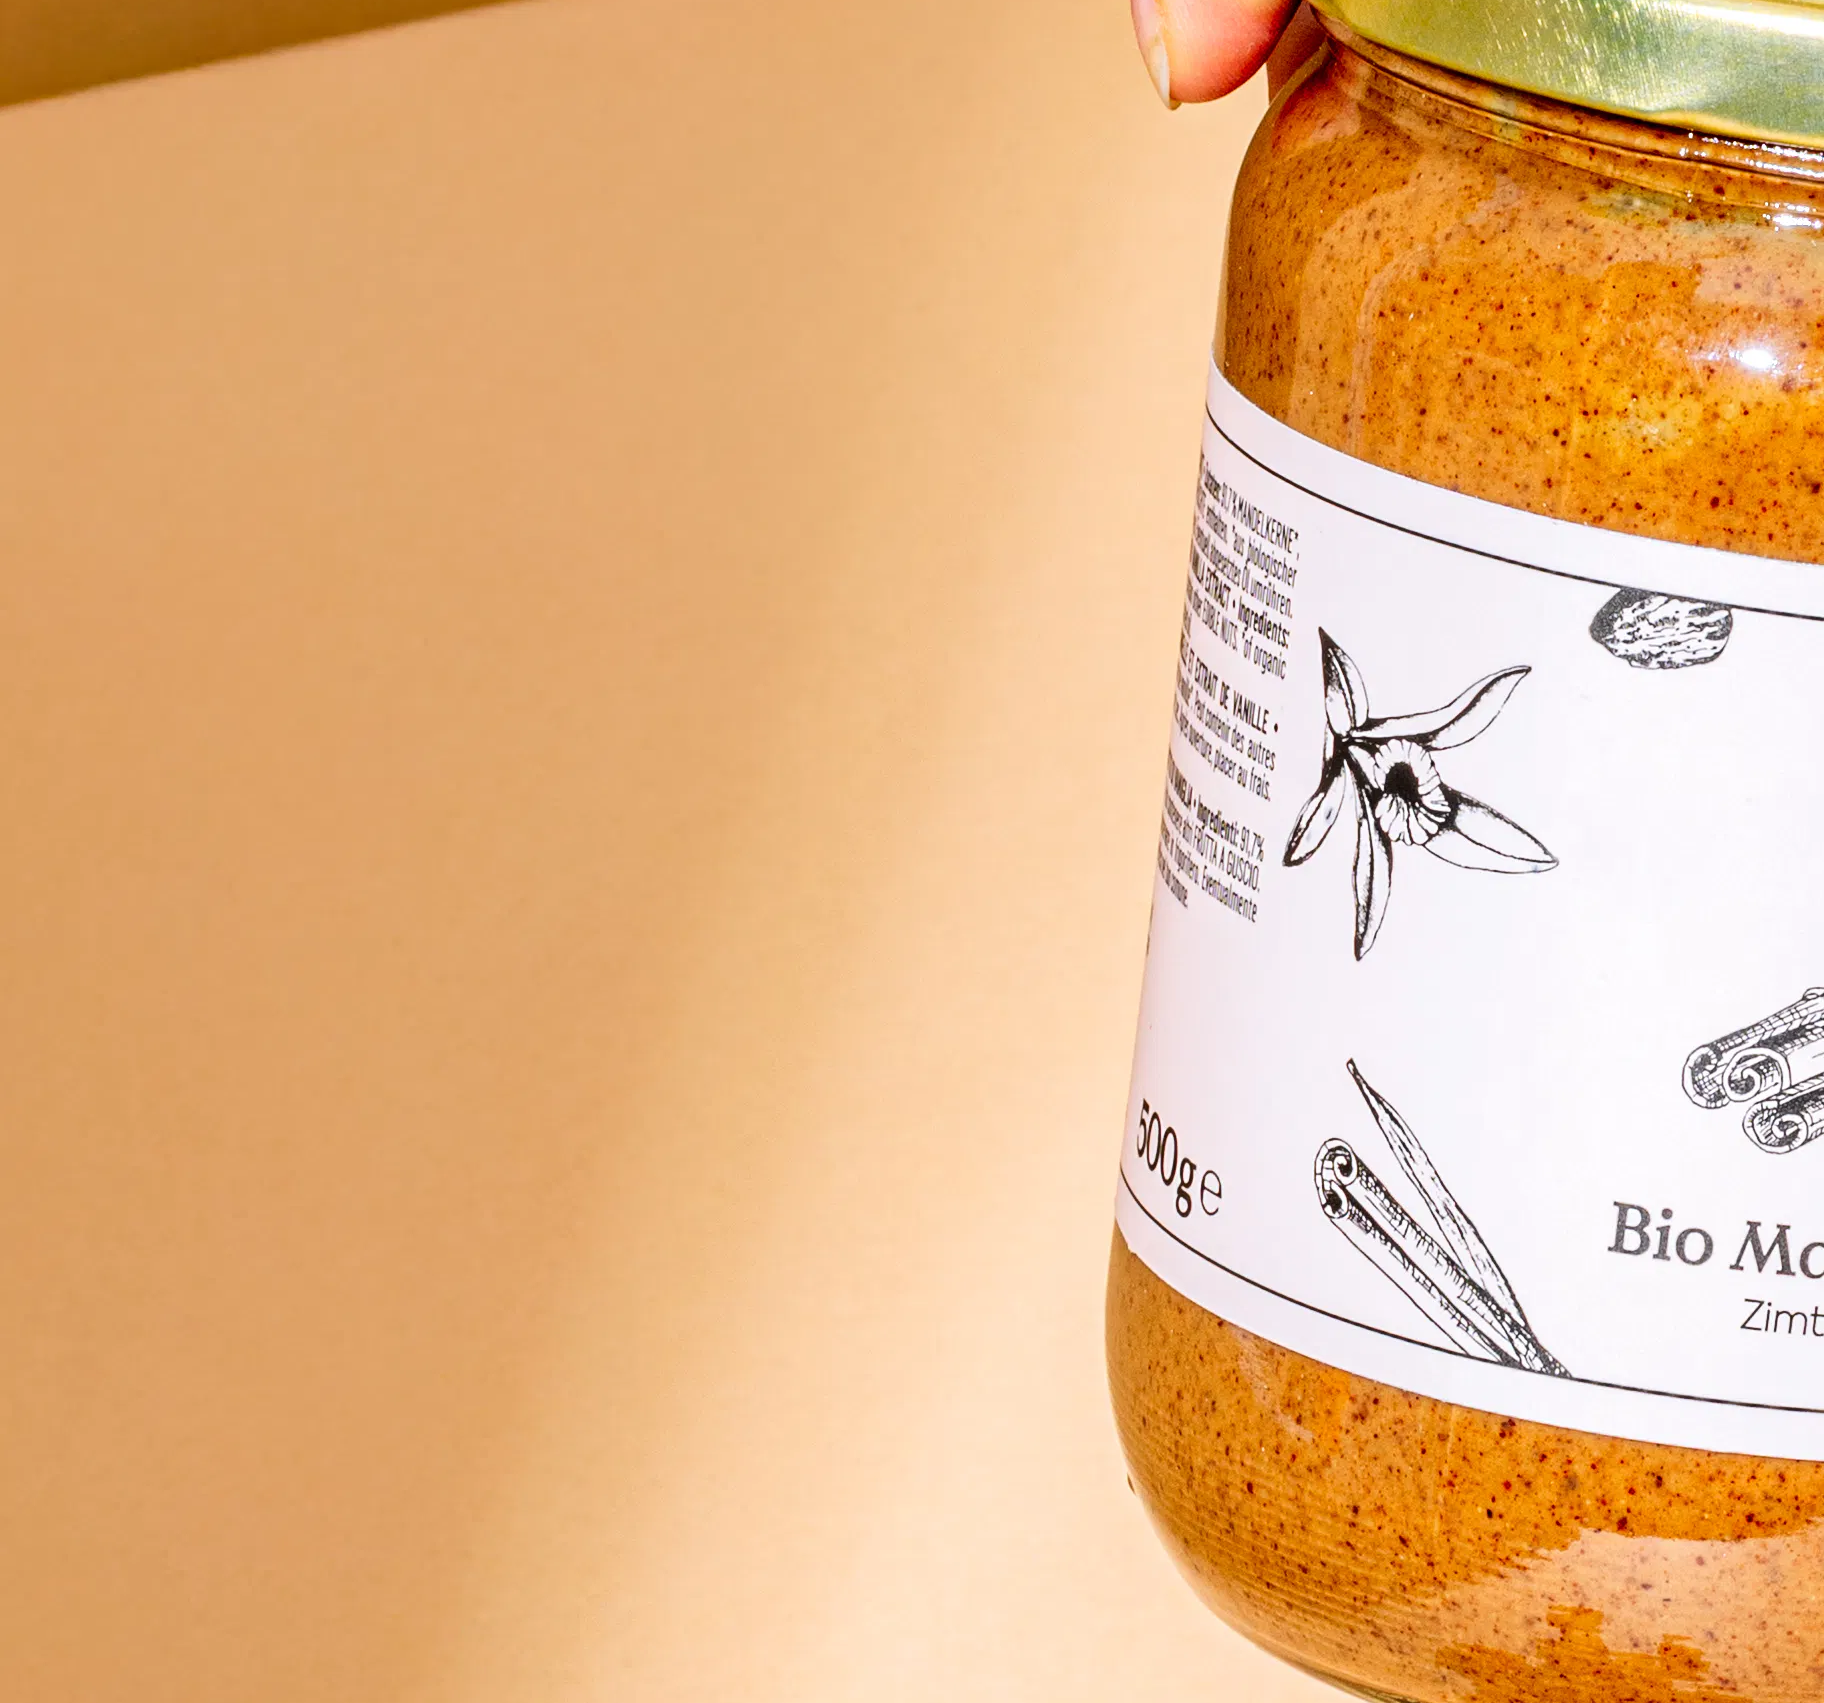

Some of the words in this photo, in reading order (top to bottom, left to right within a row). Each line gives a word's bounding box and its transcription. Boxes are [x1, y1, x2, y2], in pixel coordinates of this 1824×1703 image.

[1245, 537, 1297, 587] biologischer
[1241, 564, 1250, 593] Öl
[1249, 579, 1292, 619] umrühren.
[1237, 596, 1290, 649] Ingredients:
[1253, 645, 1286, 680] organic
[1219, 681, 1230, 710] DE
[1232, 690, 1269, 735] VANILLE
[1230, 724, 1245, 754] des
[1247, 739, 1276, 771] autres
[1213, 748, 1237, 779] placer
[1236, 765, 1248, 788] au
[1249, 766, 1270, 802] frais.
[1192, 824, 1218, 865] FRUTTA
[1218, 846, 1225, 870] A
[1226, 849, 1260, 892] GUSCIO.
[1239, 825, 1265, 862] 91,7%
[1201, 864, 1257, 923] Eventualmente
[1607, 1201, 1714, 1266] Bio
